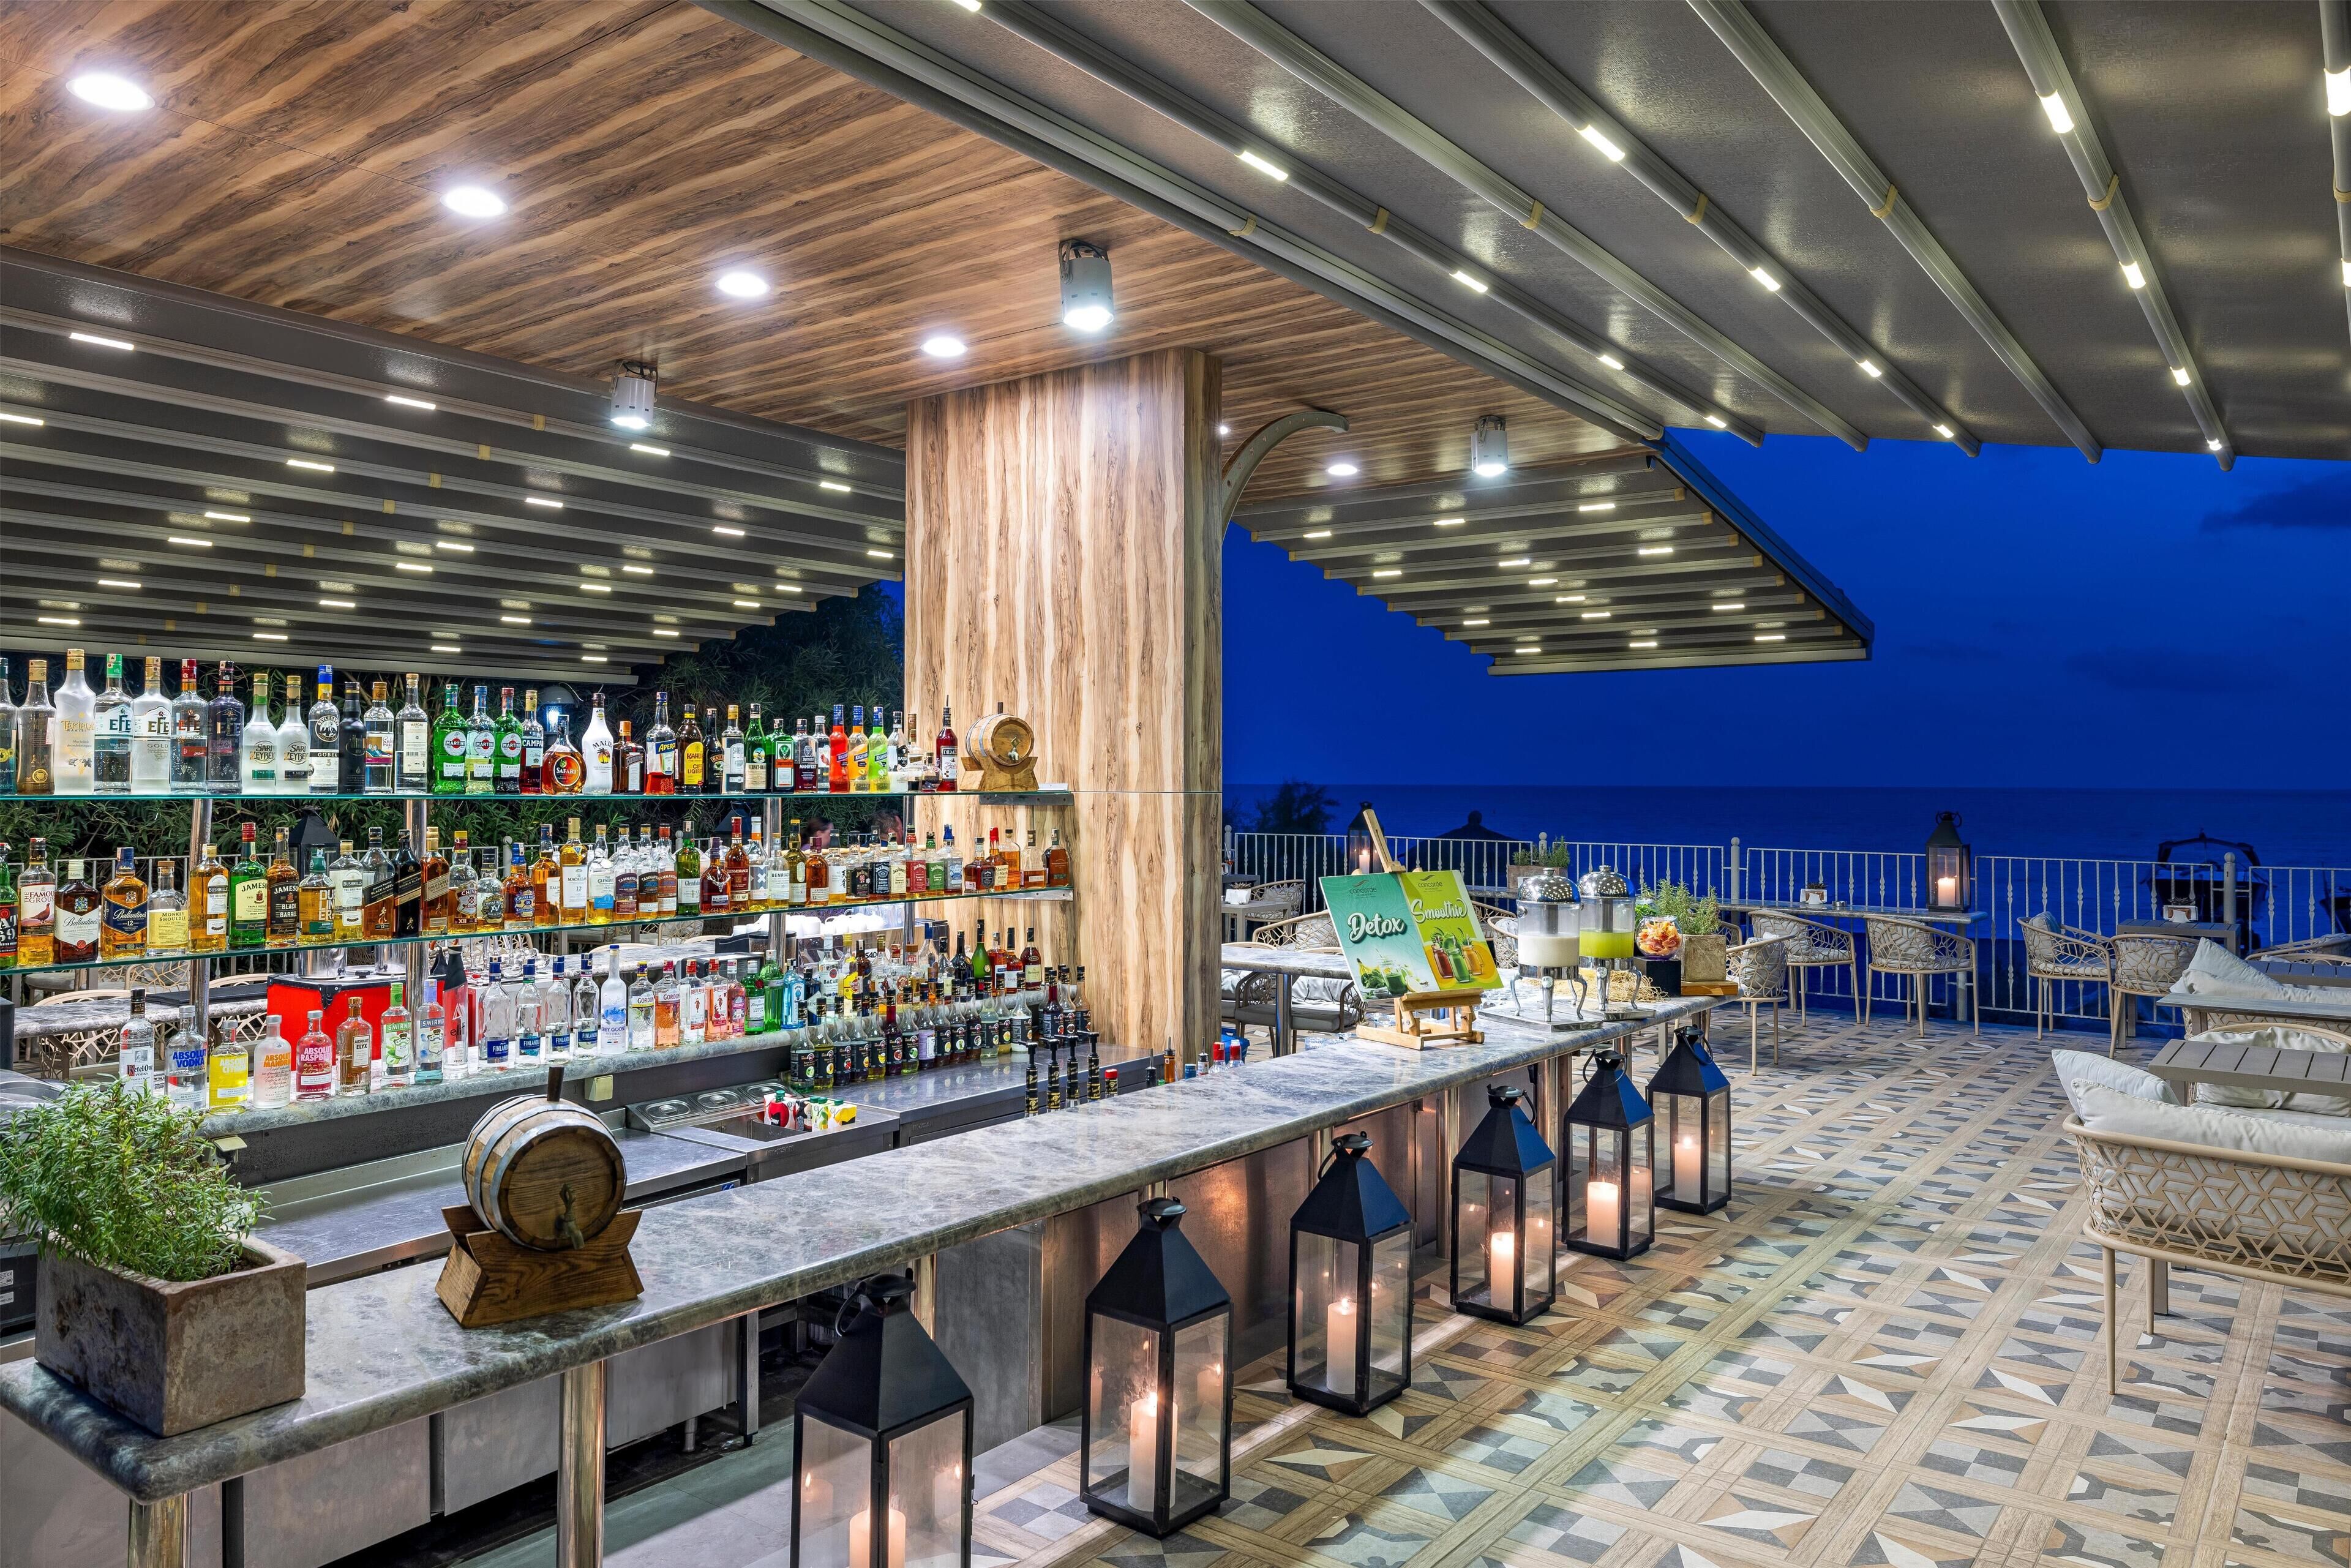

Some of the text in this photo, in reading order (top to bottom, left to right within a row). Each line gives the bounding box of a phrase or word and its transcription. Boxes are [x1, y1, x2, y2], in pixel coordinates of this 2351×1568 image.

[109, 715, 132, 733] EFE
[148, 717, 170, 734] EFE
[178, 715, 201, 735] EFE
[522, 739, 544, 748] CAMPA
[113, 909, 147, 920] Ballantine's
[1410, 898, 1468, 923] Smoothie
[0, 914, 17, 929] AT
[63, 917, 99, 927] Ballantine's
[1347, 912, 1406, 943] Detox
[173, 1049, 206, 1060] ABSOLUT
[304, 1046, 332, 1055] ABSOLUT
[264, 1052, 290, 1062] ABSOLUT
[176, 1058, 204, 1068] VODKA
[263, 1059, 290, 1068] MANDRI
[127, 1064, 144, 1076] Ketel
